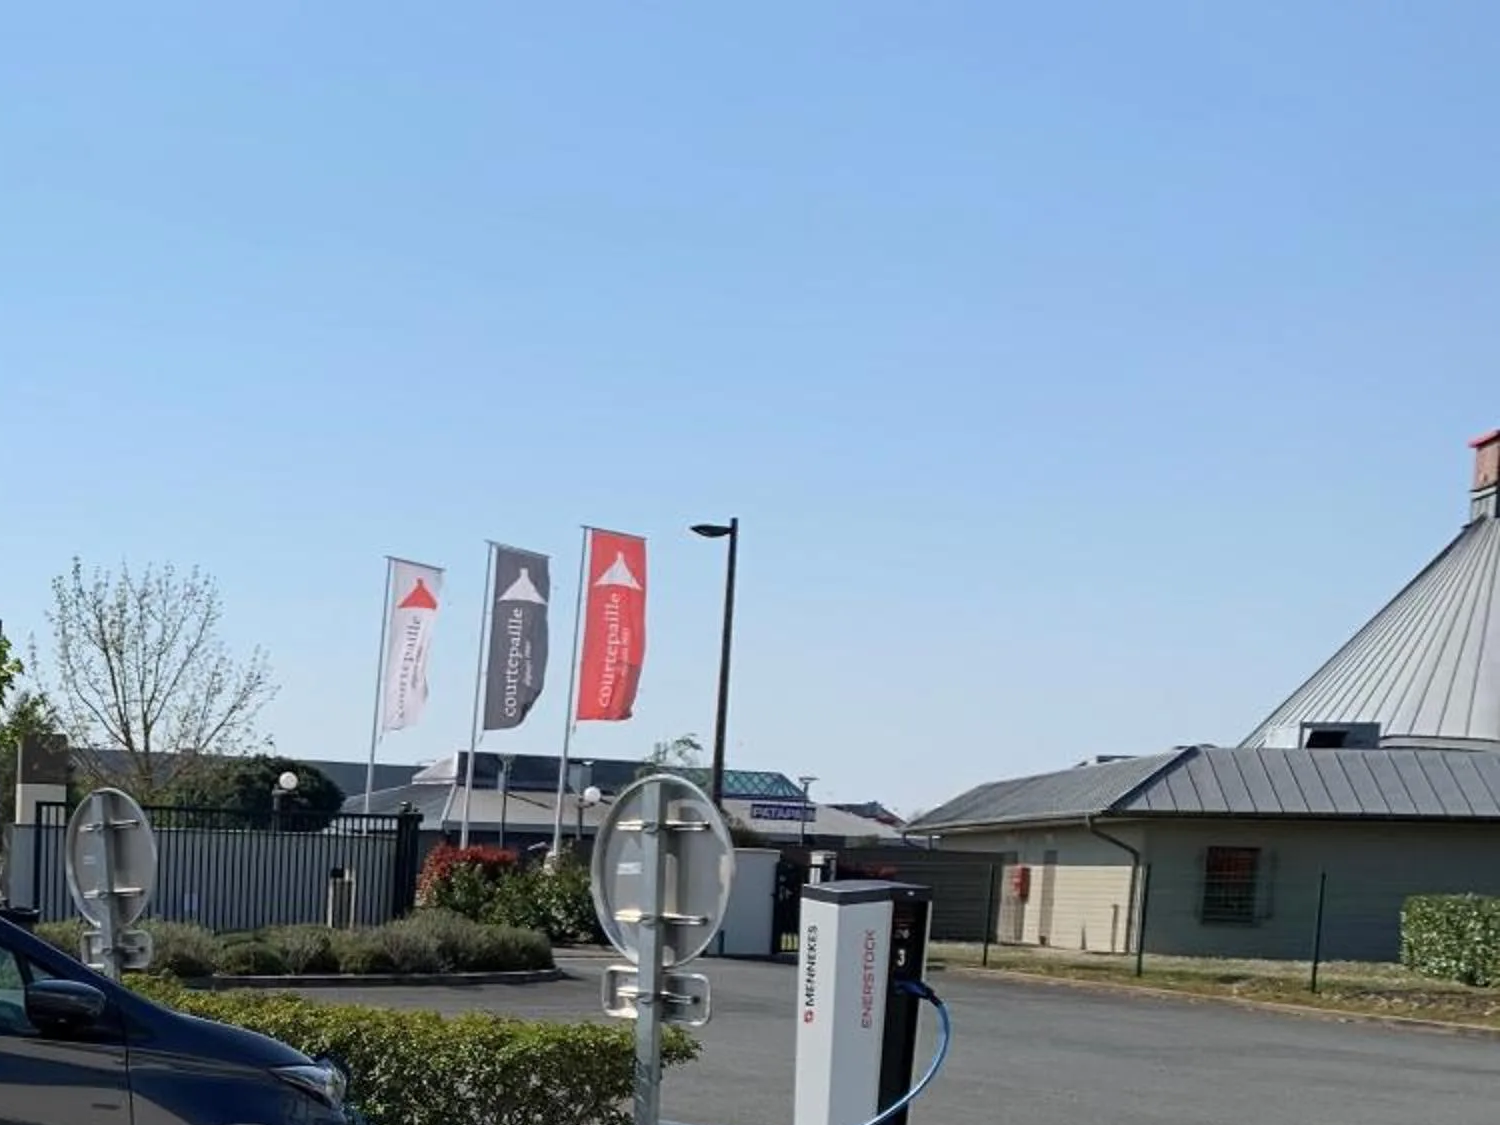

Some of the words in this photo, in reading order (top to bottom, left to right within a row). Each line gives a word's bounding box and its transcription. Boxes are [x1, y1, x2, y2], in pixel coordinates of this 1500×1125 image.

[504, 607, 523, 717] courtepaille
[598, 592, 621, 708] courtepaille
[804, 925, 818, 1007] MENNEKES
[860, 928, 876, 1029] ENERSTOCK
[896, 948, 906, 967] 3
